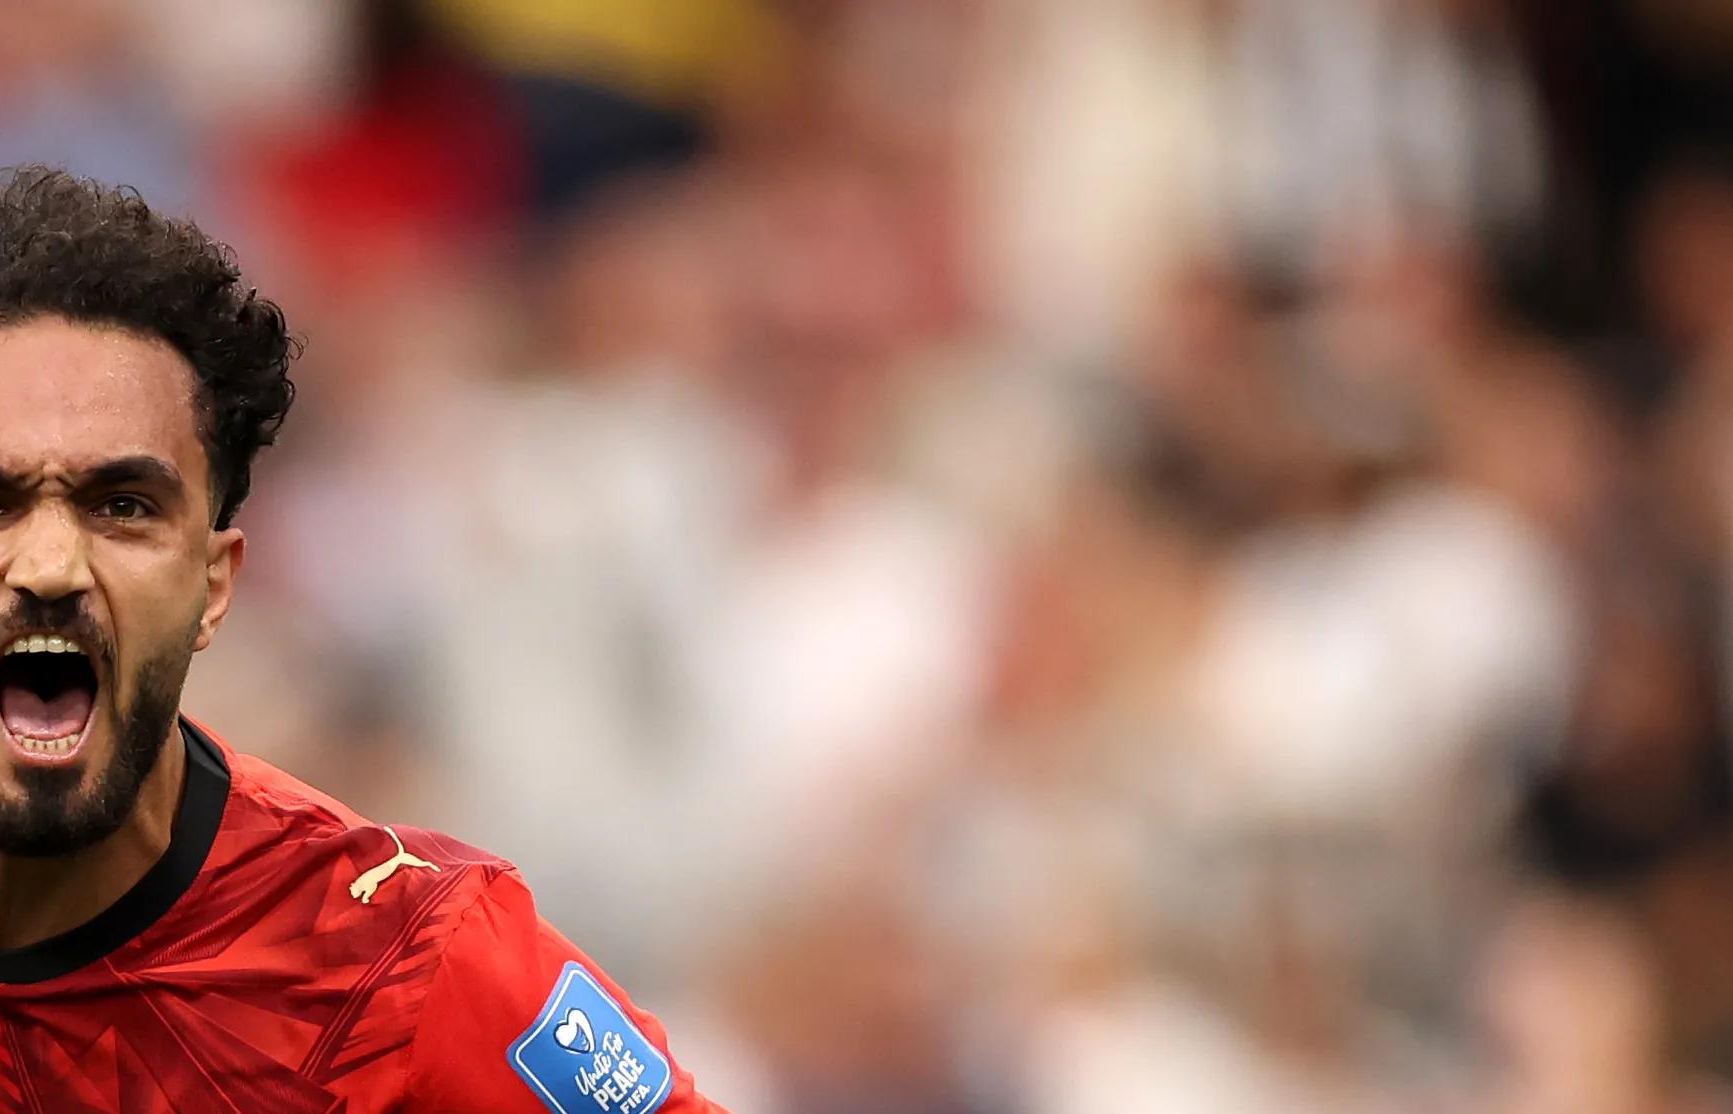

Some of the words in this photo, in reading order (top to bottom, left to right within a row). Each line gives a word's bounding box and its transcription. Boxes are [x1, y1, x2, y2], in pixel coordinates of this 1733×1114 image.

[575, 1051, 611, 1095] Unite
[602, 1031, 624, 1061] For
[593, 1050, 645, 1112] PEACE
[620, 1084, 650, 1114] FIFA
